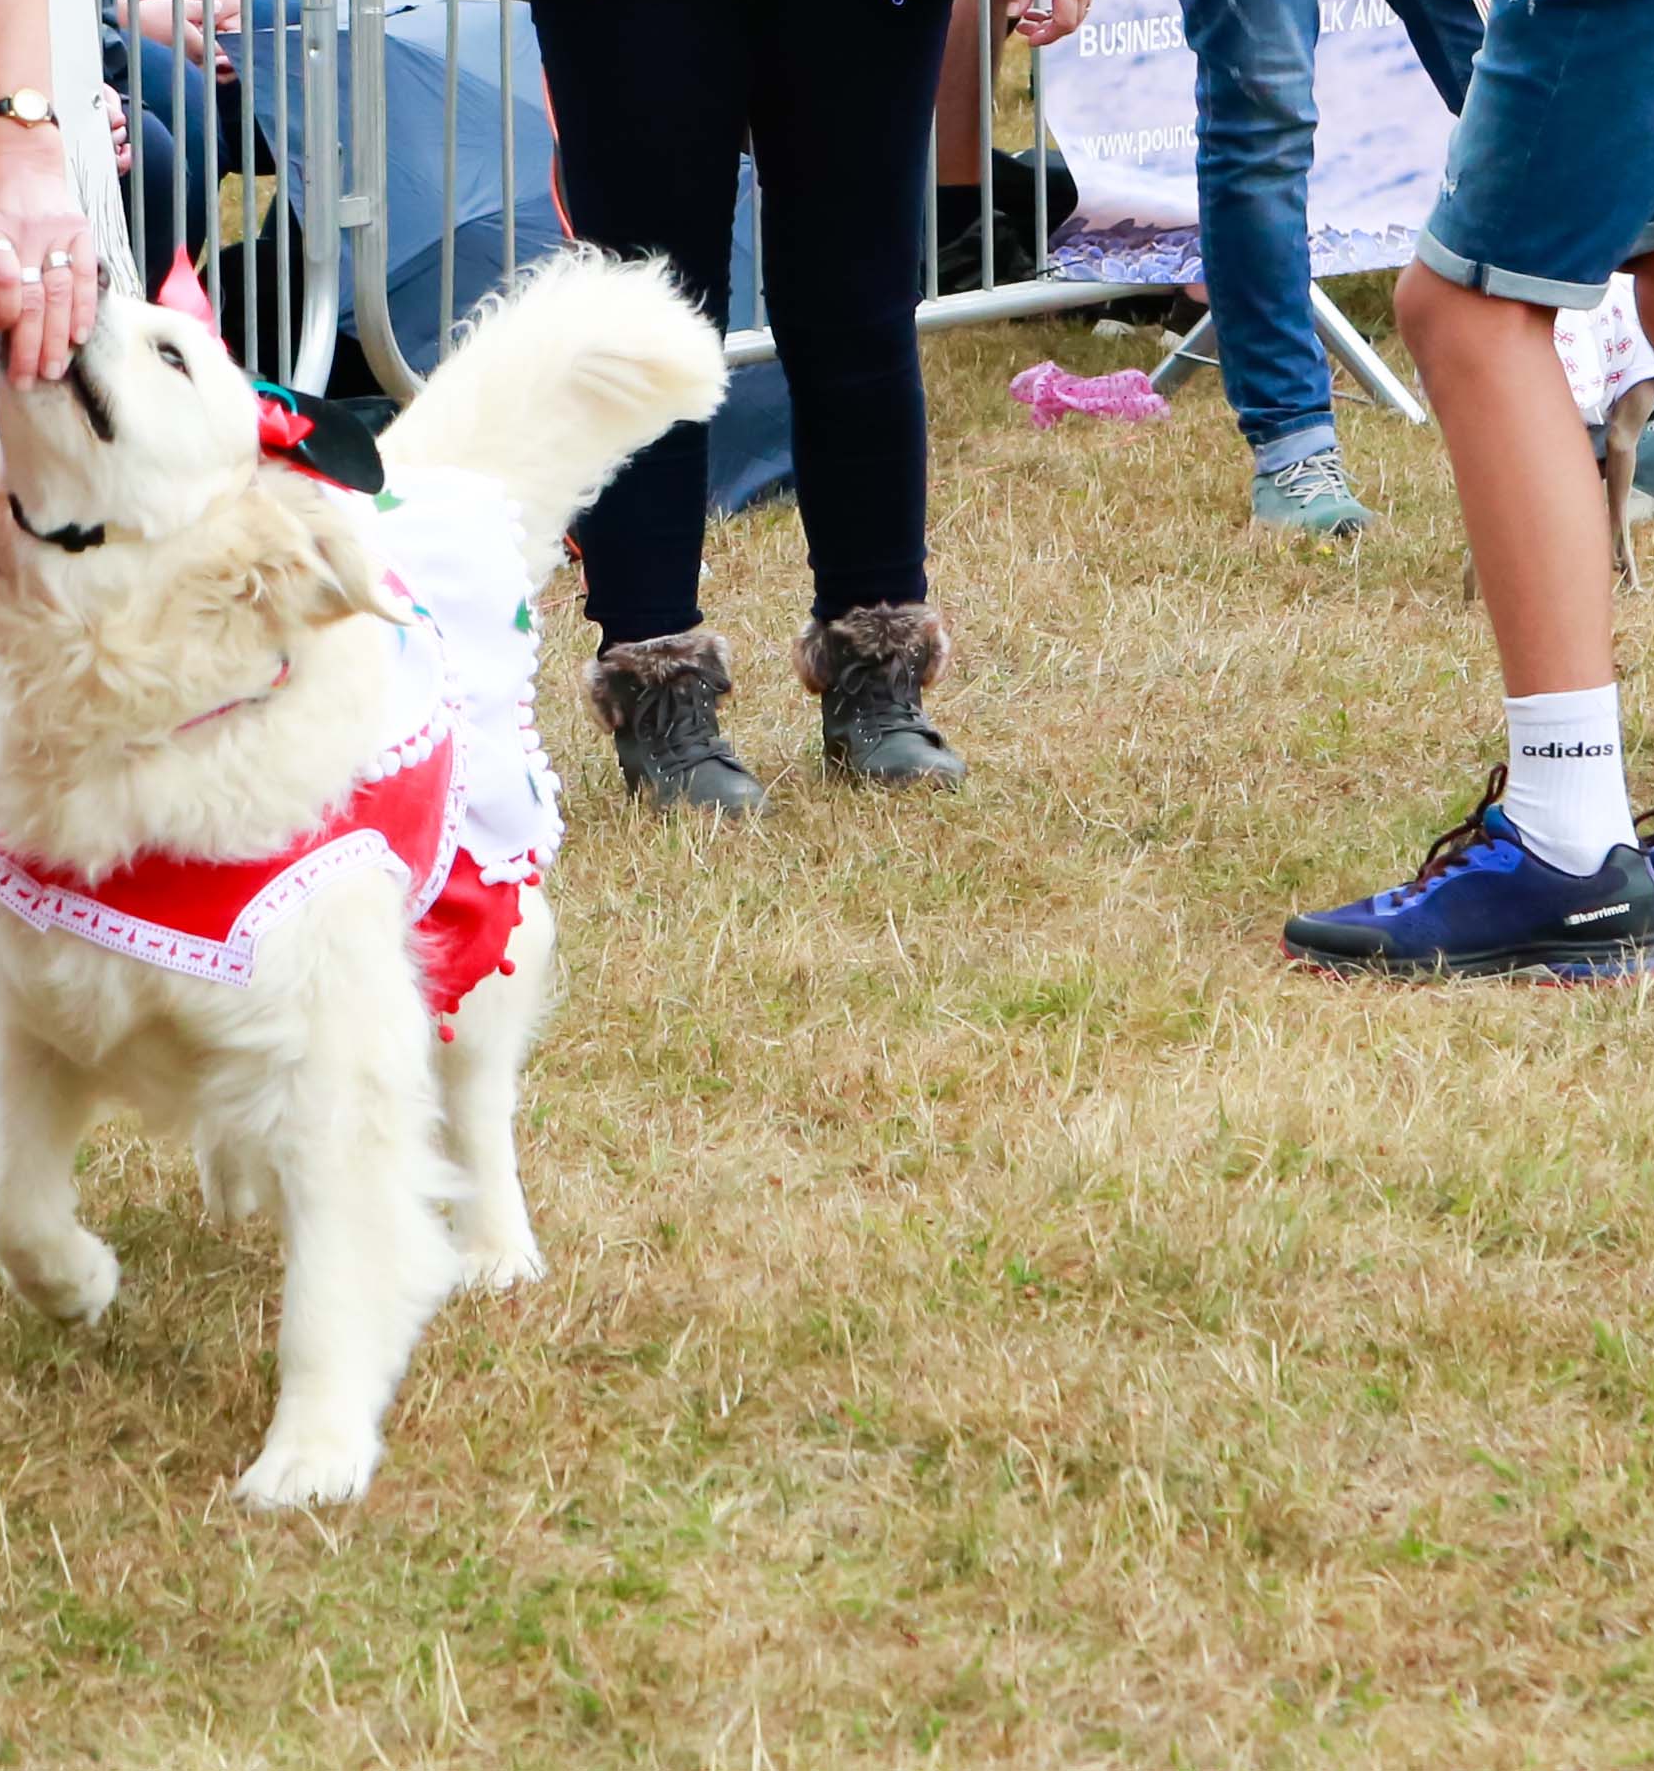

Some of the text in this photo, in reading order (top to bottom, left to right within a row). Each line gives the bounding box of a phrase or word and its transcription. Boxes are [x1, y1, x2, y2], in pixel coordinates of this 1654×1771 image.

[1078, 15, 1188, 58] BUSINESS
[1522, 741, 1615, 759] adidas
[1578, 902, 1630, 924] karrimor
